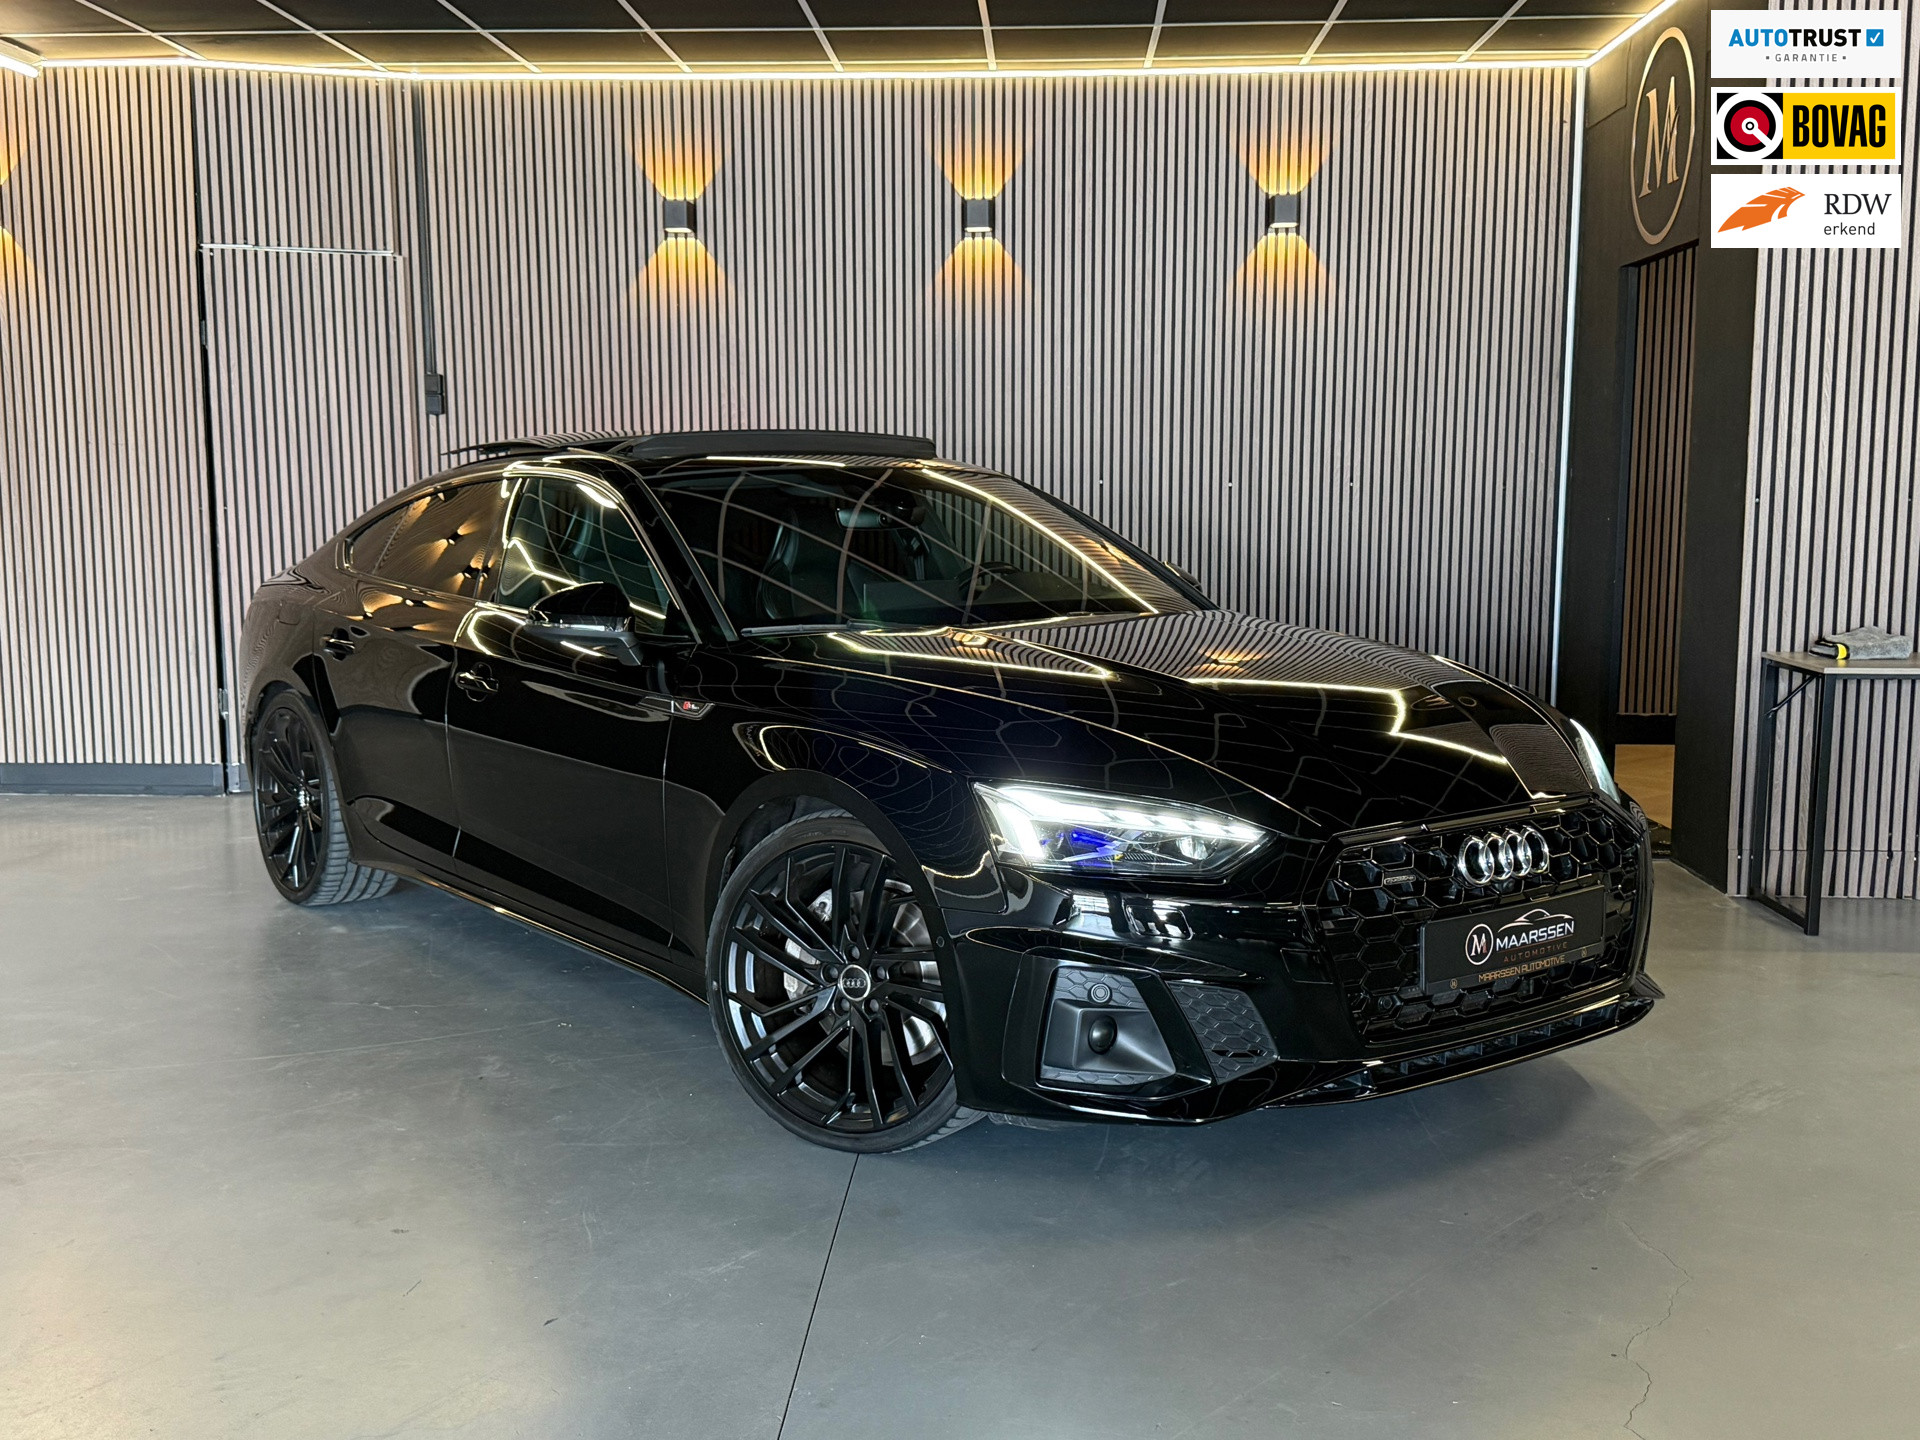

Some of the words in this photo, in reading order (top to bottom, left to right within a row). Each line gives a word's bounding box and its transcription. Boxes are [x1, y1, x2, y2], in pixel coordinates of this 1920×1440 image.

[1496, 921, 1575, 951] MAARSSEN
[1503, 941, 1568, 963] AUTOMOTIVE
[1478, 965, 1521, 982] MAARSSEN
[1521, 954, 1566, 973] AUTOMOTIVE
